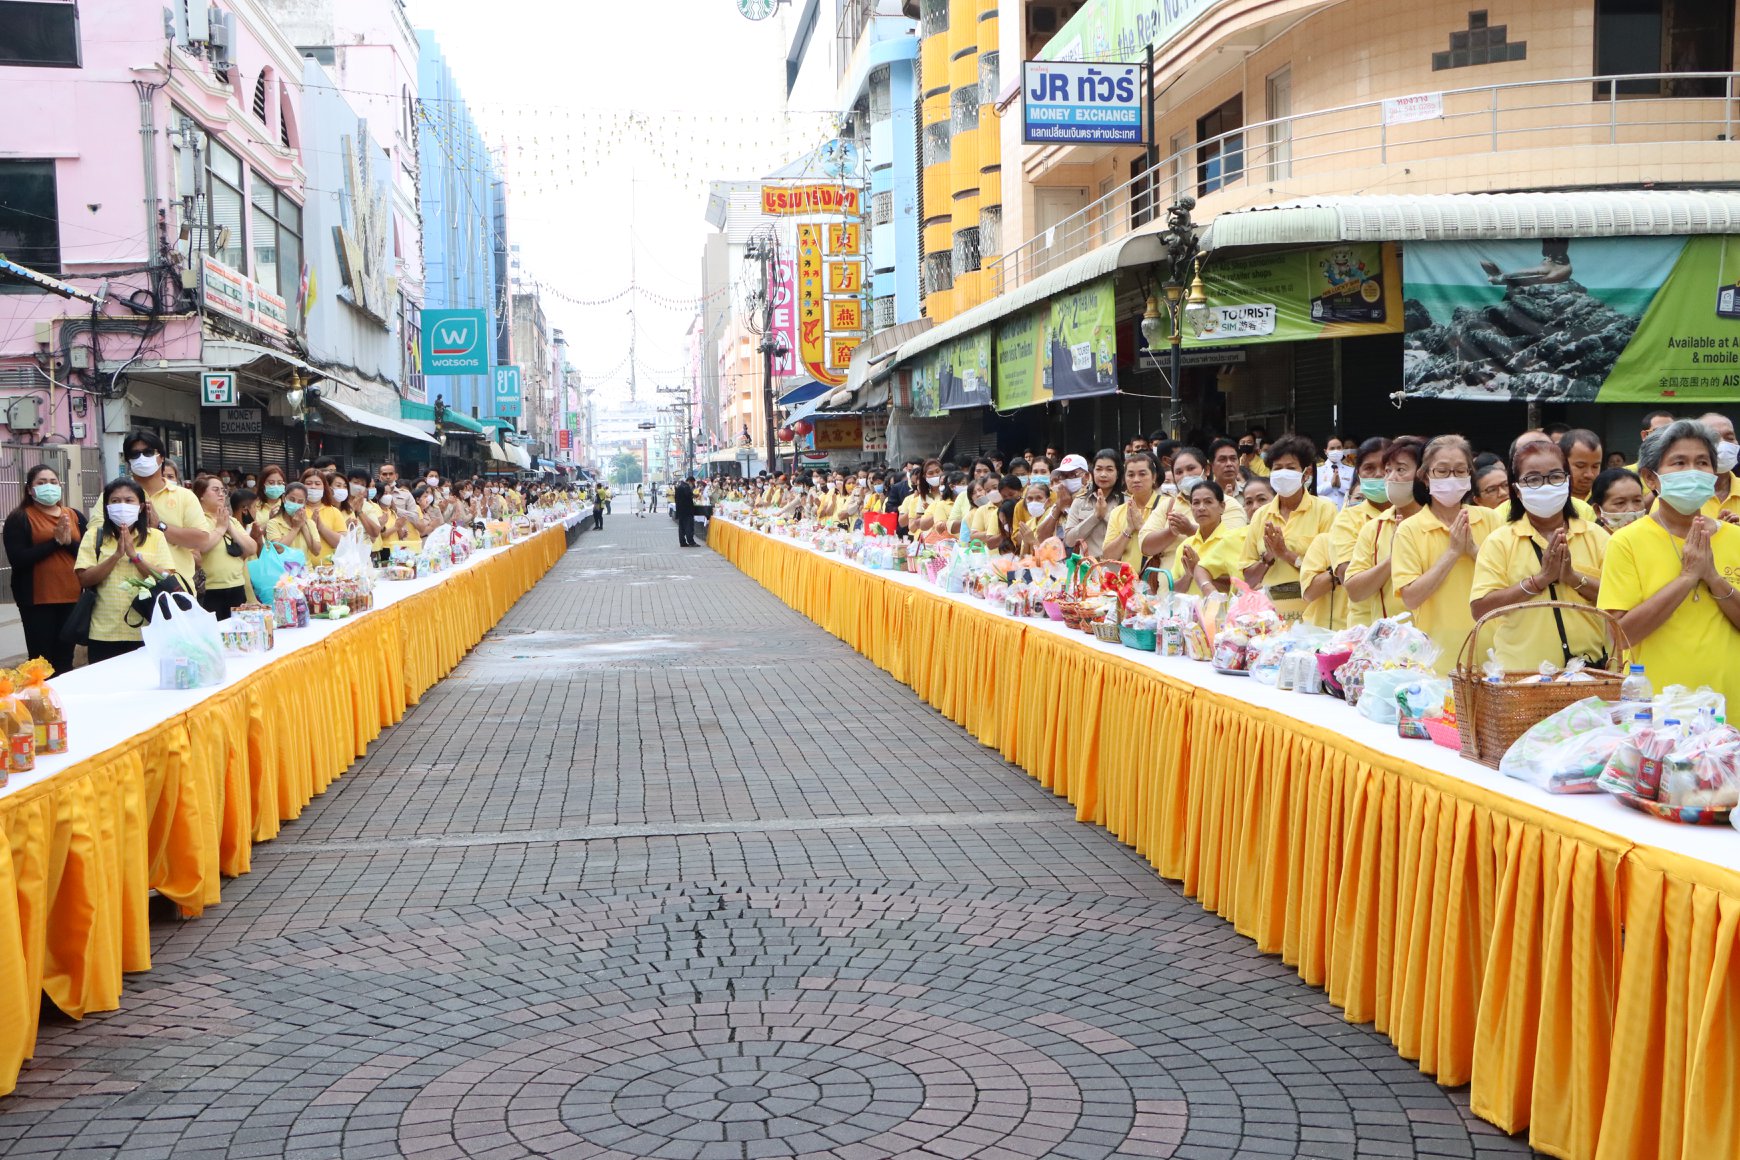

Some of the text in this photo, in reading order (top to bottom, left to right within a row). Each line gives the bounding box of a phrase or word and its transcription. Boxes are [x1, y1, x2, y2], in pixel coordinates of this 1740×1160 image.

[1031, 68, 1134, 103] JR ทัวร์
[1030, 108, 1136, 121] MONEY EXCHANGE
[1031, 124, 1136, 139] แลกเปลี่ยนเงินตราต่างประเทศ
[1222, 307, 1273, 321] TOURIST
[1222, 323, 1237, 332] SIM
[1668, 337, 1716, 349] Available
[1718, 338, 1730, 348] at
[431, 359, 479, 367] watsons
[1692, 351, 1739, 363] & mobile
[497, 370, 518, 394] ยา
[1722, 374, 1740, 387] AIS
[227, 409, 255, 420] MONEY
[220, 421, 261, 433] EXCHANGE
